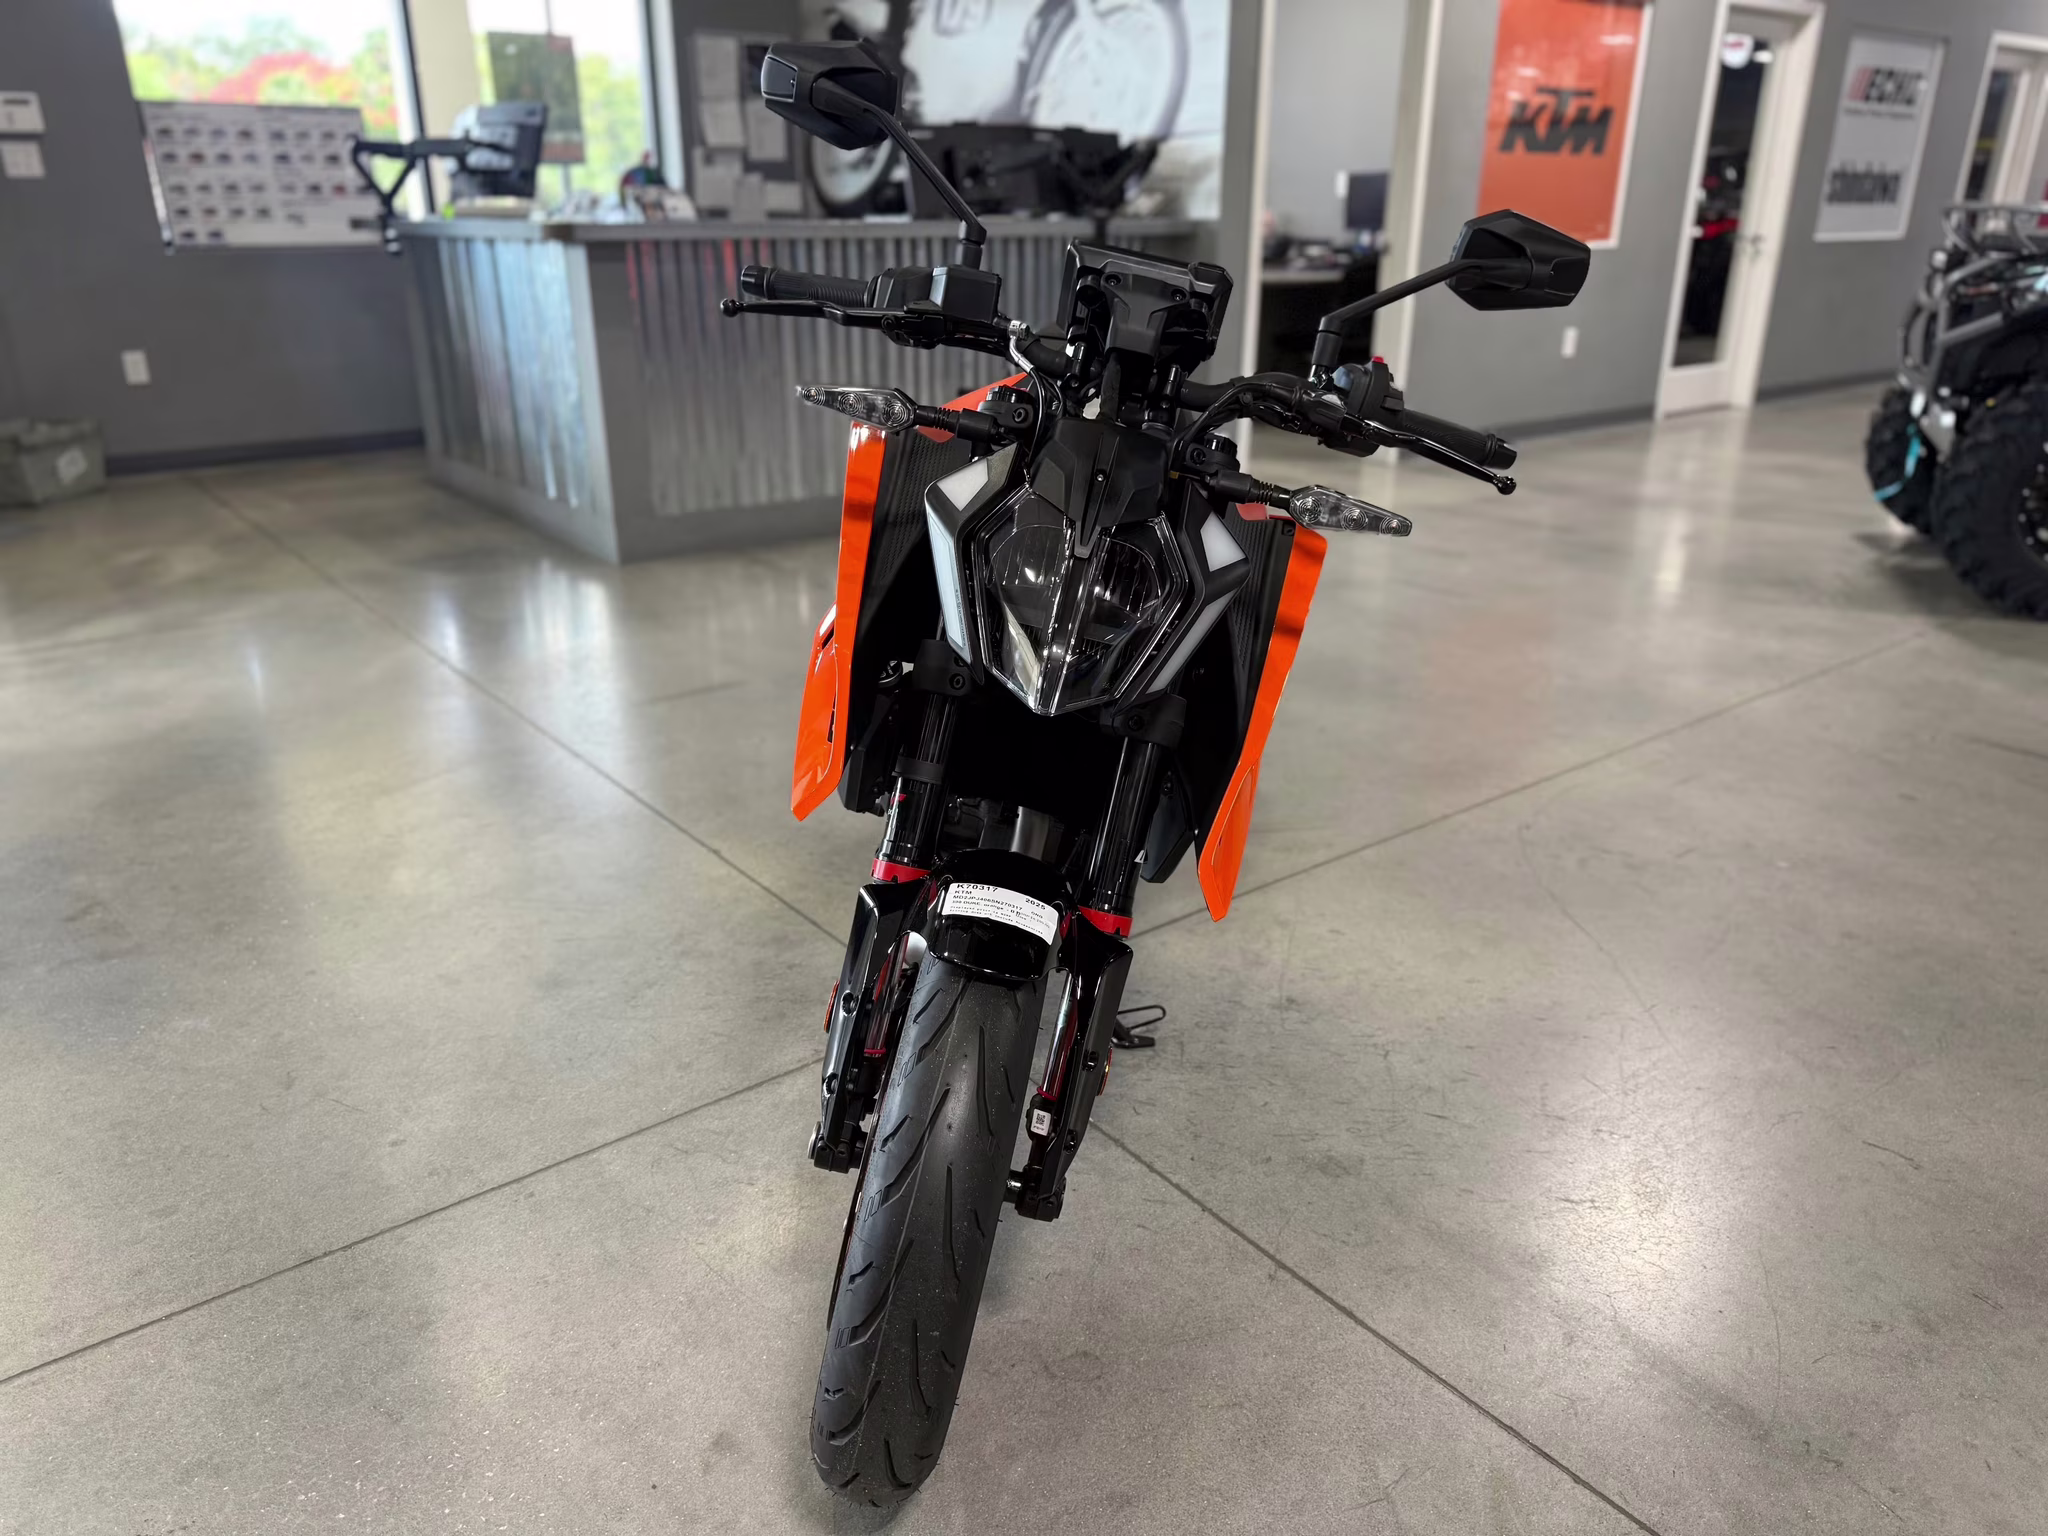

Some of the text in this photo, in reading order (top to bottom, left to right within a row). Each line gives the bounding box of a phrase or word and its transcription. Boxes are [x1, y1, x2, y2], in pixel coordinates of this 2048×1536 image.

[1498, 86, 1614, 156] KTM
[957, 884, 998, 892] K70317
[1025, 897, 1046, 910] 2025
